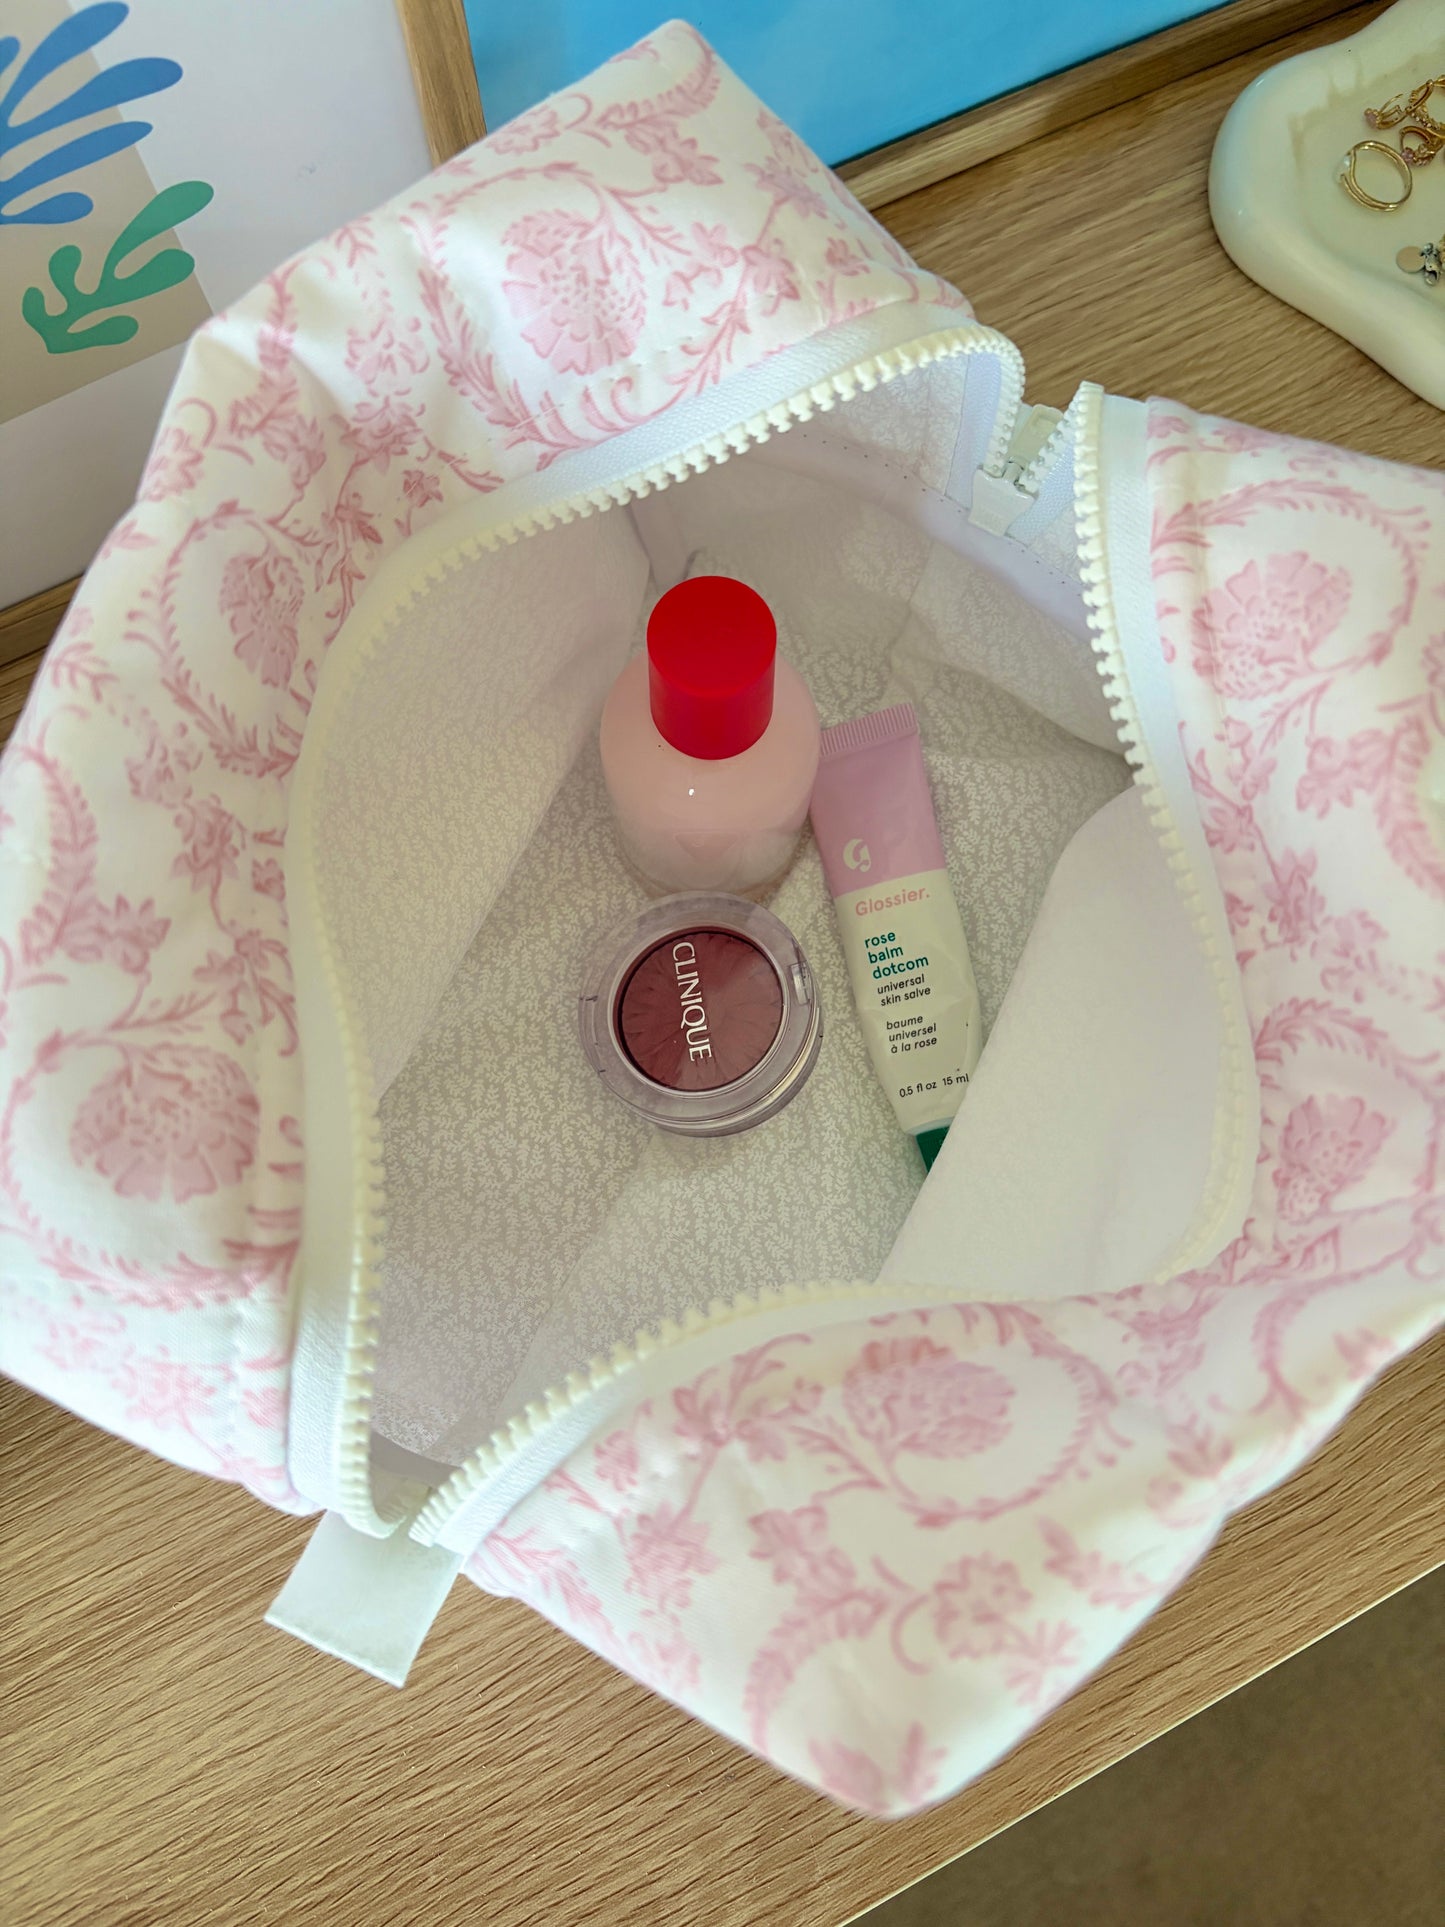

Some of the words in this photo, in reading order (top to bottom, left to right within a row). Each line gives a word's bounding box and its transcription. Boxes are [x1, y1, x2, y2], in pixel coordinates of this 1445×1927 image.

[855, 888, 930, 916] Glossier.
[864, 932, 896, 949] rose
[868, 946, 904, 964] balm
[872, 956, 929, 980] dotcom
[877, 974, 925, 994] universal
[672, 941, 712, 1062] CLINIQUE
[880, 994, 901, 1007] skin
[904, 987, 931, 999] salve
[886, 1015, 923, 1030] baume
[889, 1023, 937, 1042] universel
[891, 1043, 898, 1054] à
[901, 1042, 911, 1052] la
[914, 1037, 938, 1049] rose
[899, 1086, 914, 1098] 0.5
[916, 1083, 923, 1093] fl
[926, 1081, 937, 1090] oz
[942, 1076, 953, 1086] 15
[956, 1073, 969, 1083] ml
